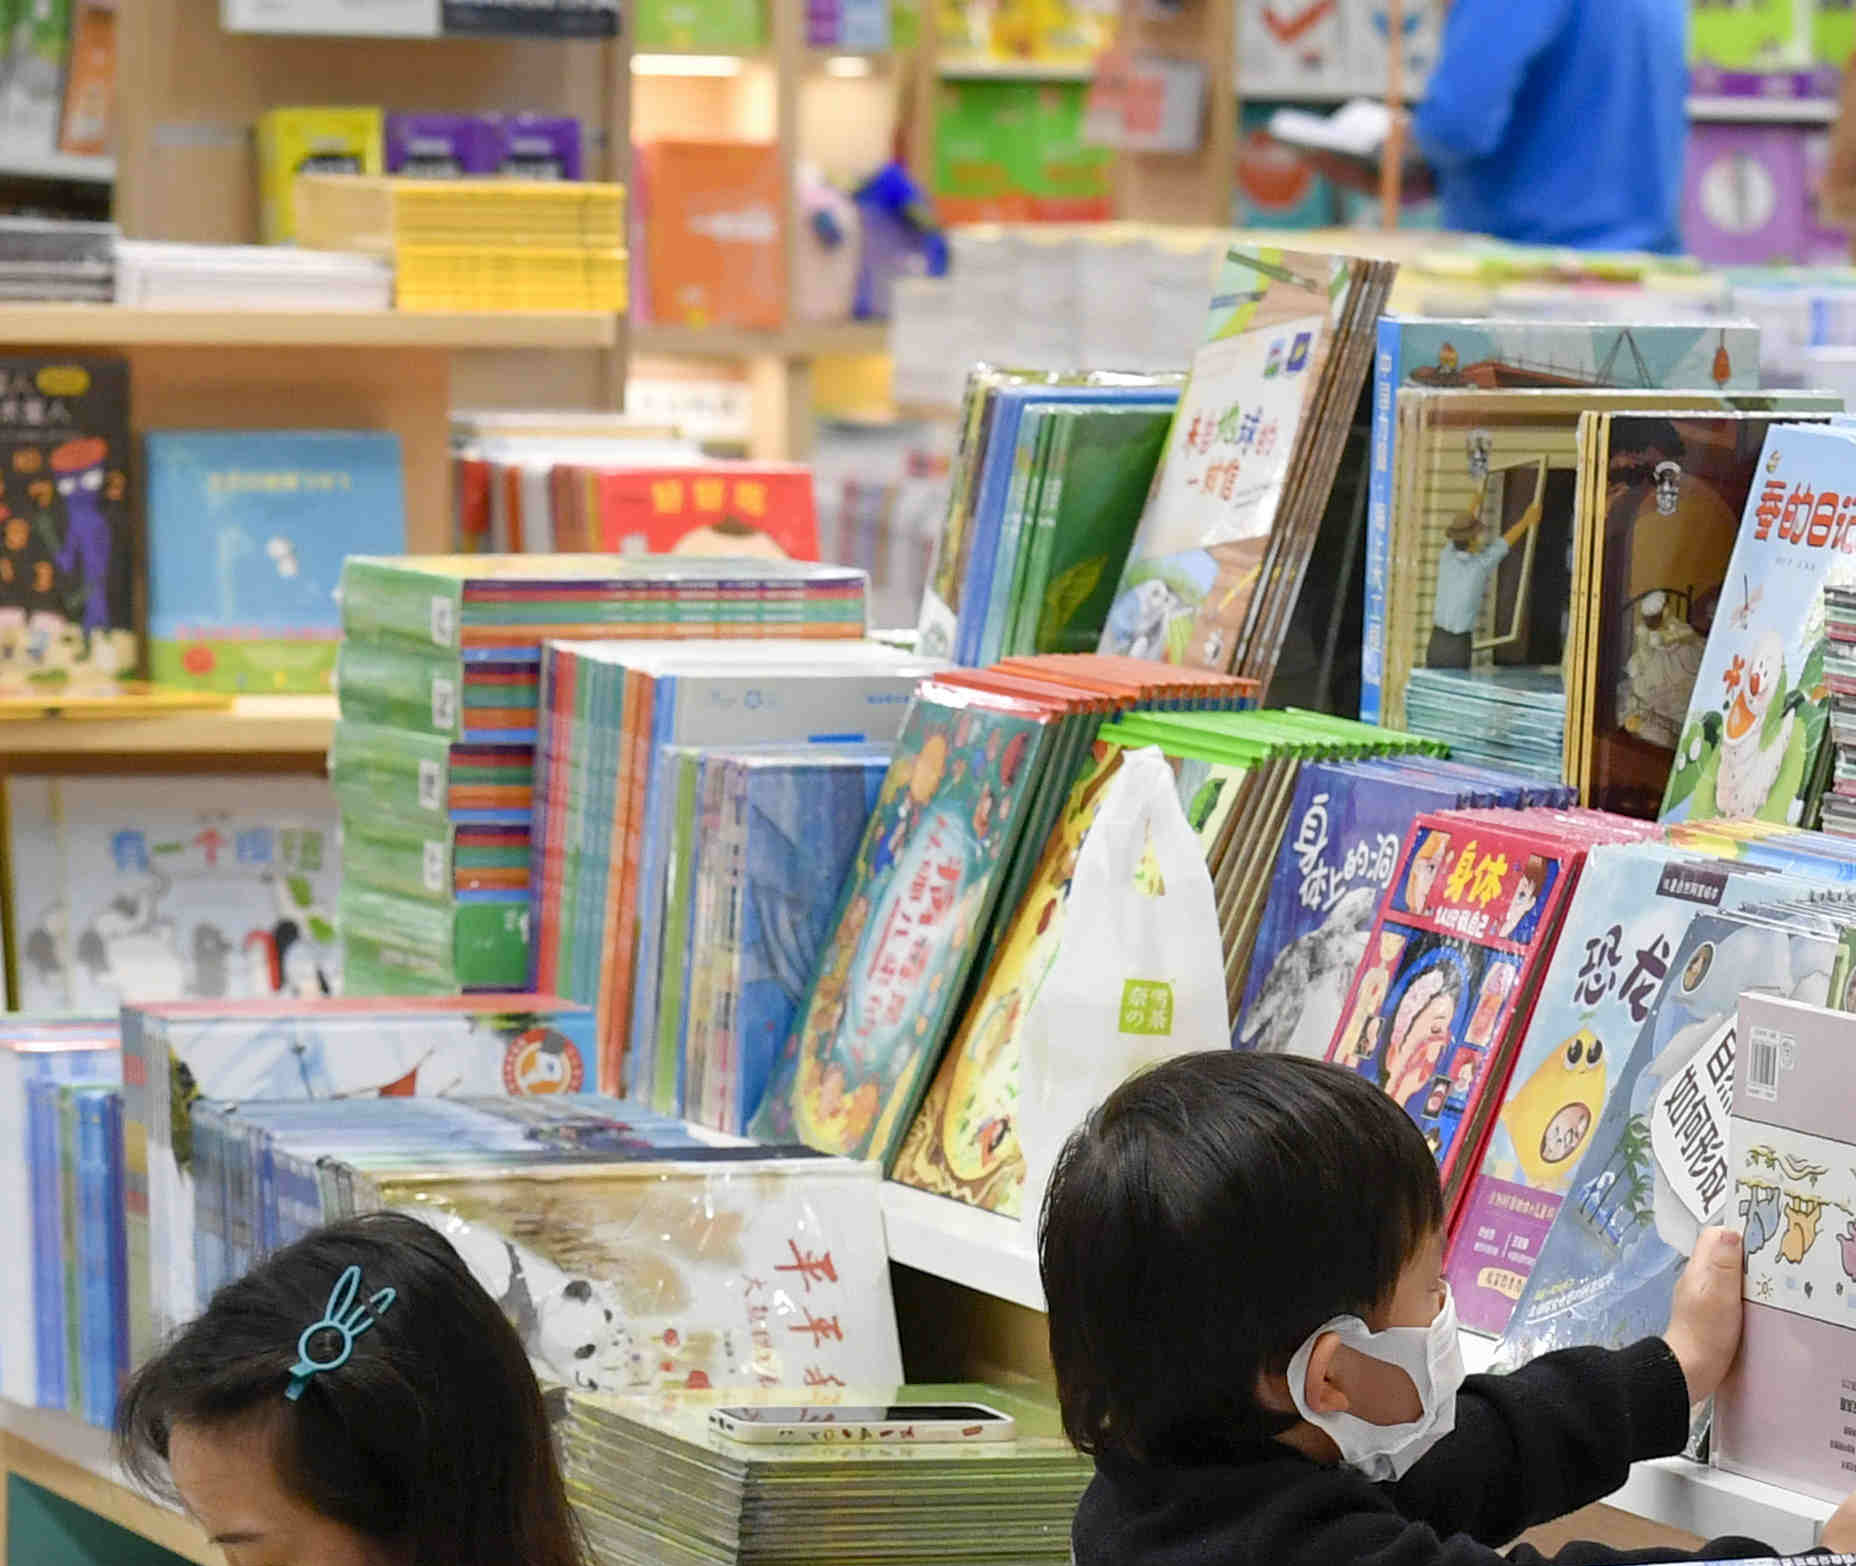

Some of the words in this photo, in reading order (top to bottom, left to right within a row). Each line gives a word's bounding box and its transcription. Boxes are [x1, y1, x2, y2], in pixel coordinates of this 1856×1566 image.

[1444, 840, 1508, 909] 身体
[1662, 1063, 1730, 1215] 如何形成
